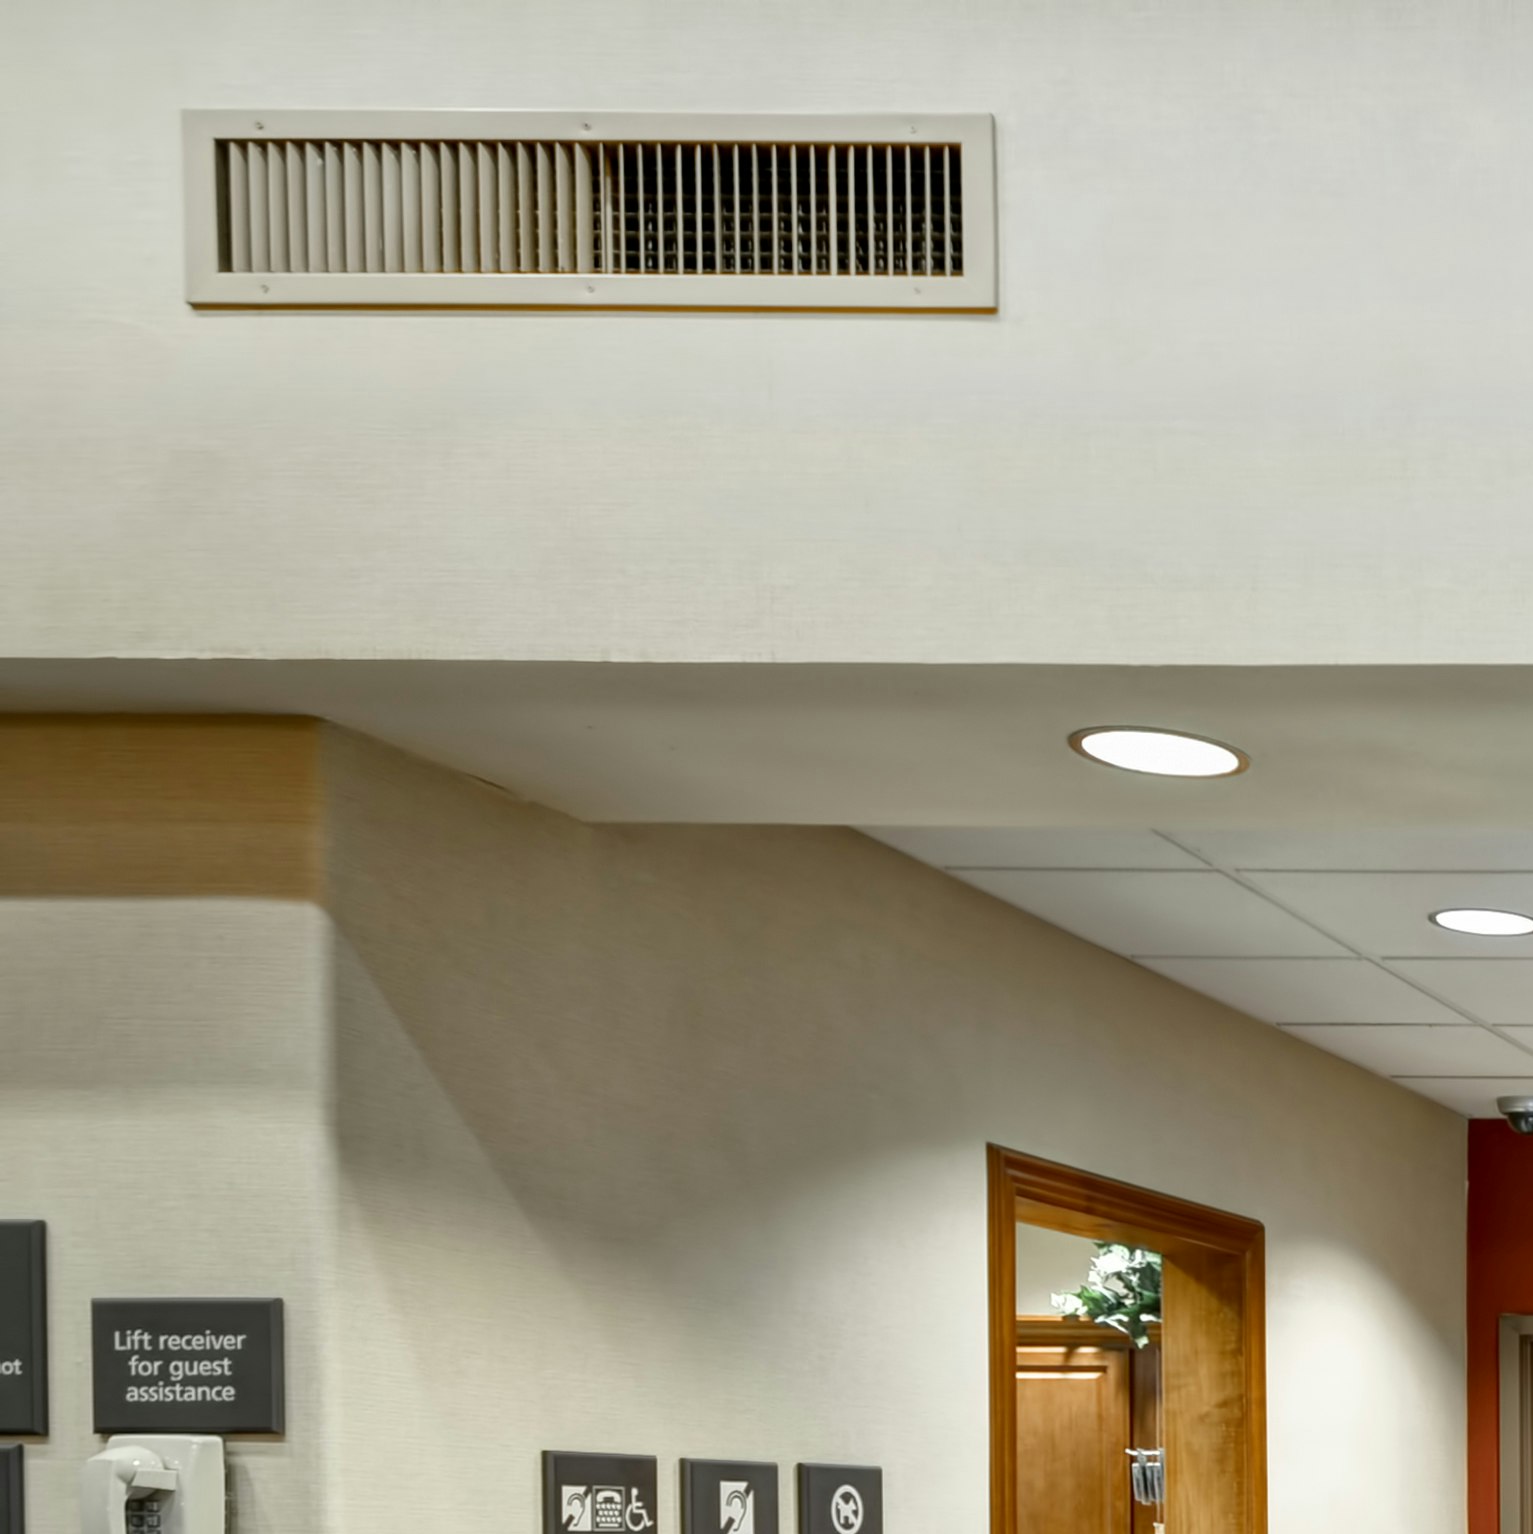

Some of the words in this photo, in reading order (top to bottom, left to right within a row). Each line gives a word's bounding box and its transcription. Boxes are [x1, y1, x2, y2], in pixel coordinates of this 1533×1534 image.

[114, 1329, 152, 1351] Lift
[159, 1329, 247, 1350] receiver
[0, 1358, 23, 1376] ot
[128, 1355, 163, 1376] for
[169, 1357, 232, 1381] guest
[125, 1381, 236, 1402] assistance
